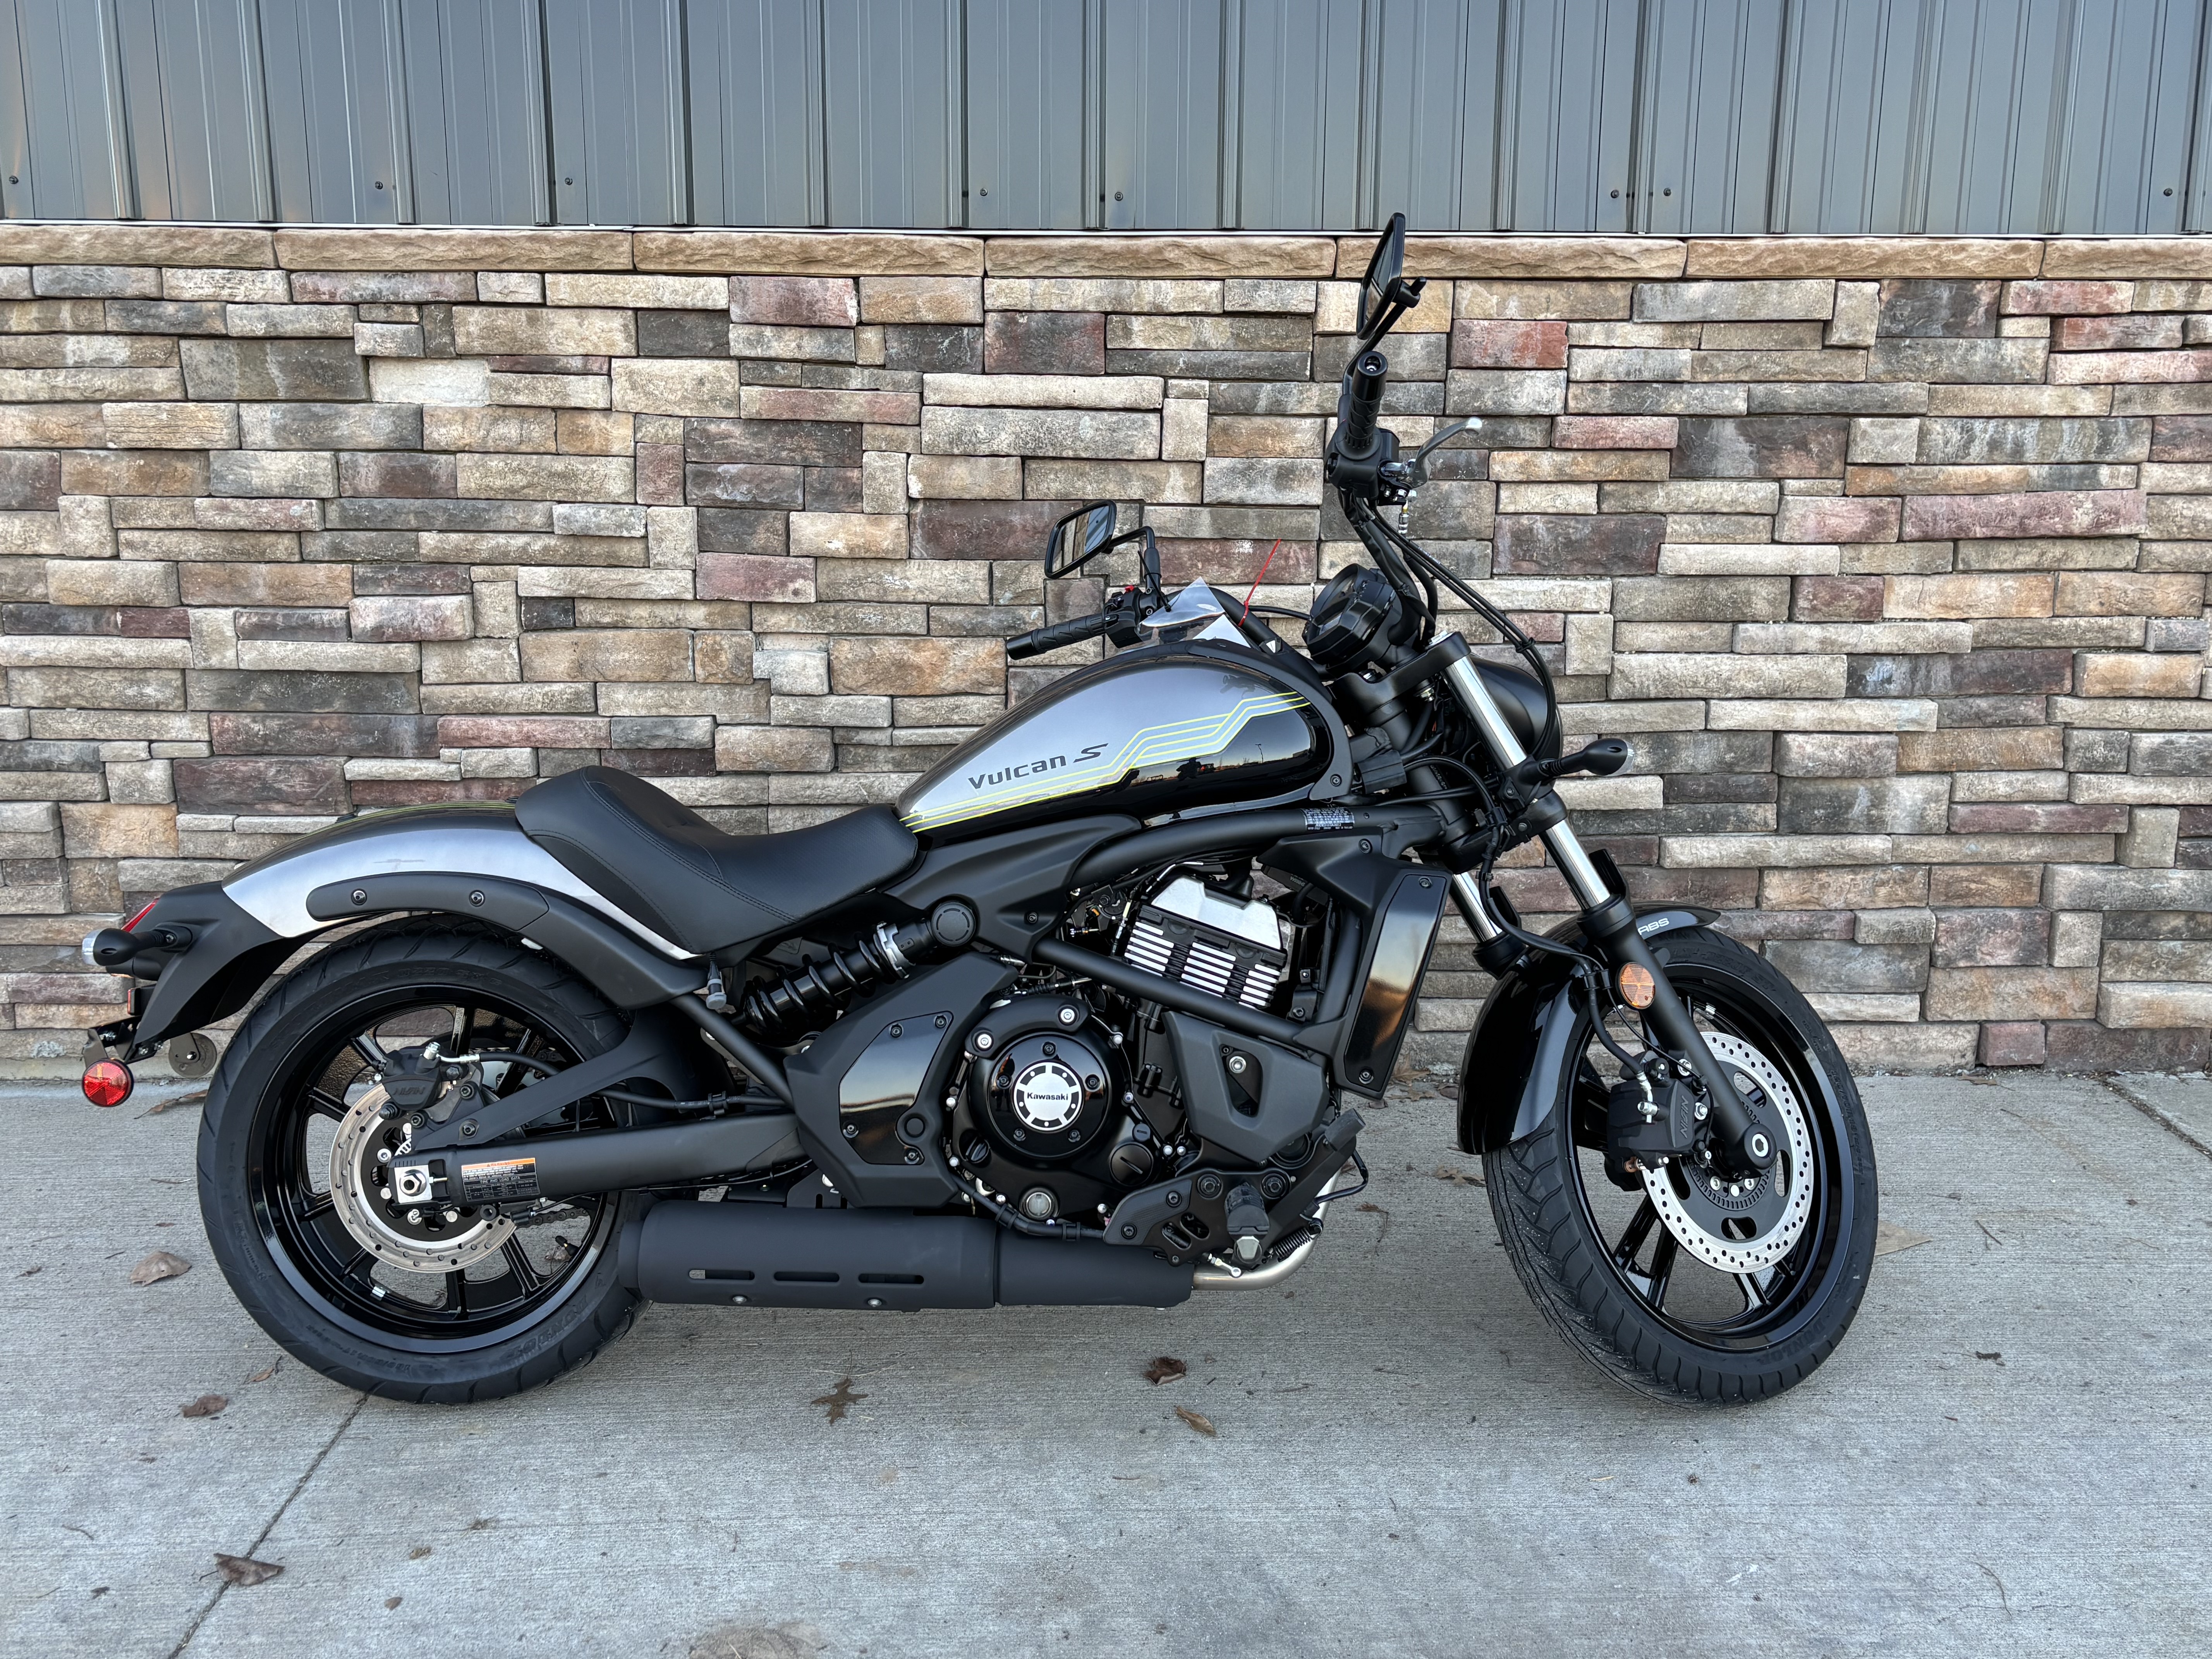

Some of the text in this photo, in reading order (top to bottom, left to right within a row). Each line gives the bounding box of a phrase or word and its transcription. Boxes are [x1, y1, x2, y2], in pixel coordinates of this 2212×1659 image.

[968, 743, 1108, 789] Vulcan S
[1638, 918, 1669, 935] ABS
[1027, 1092, 1068, 1100] Kawasaki
